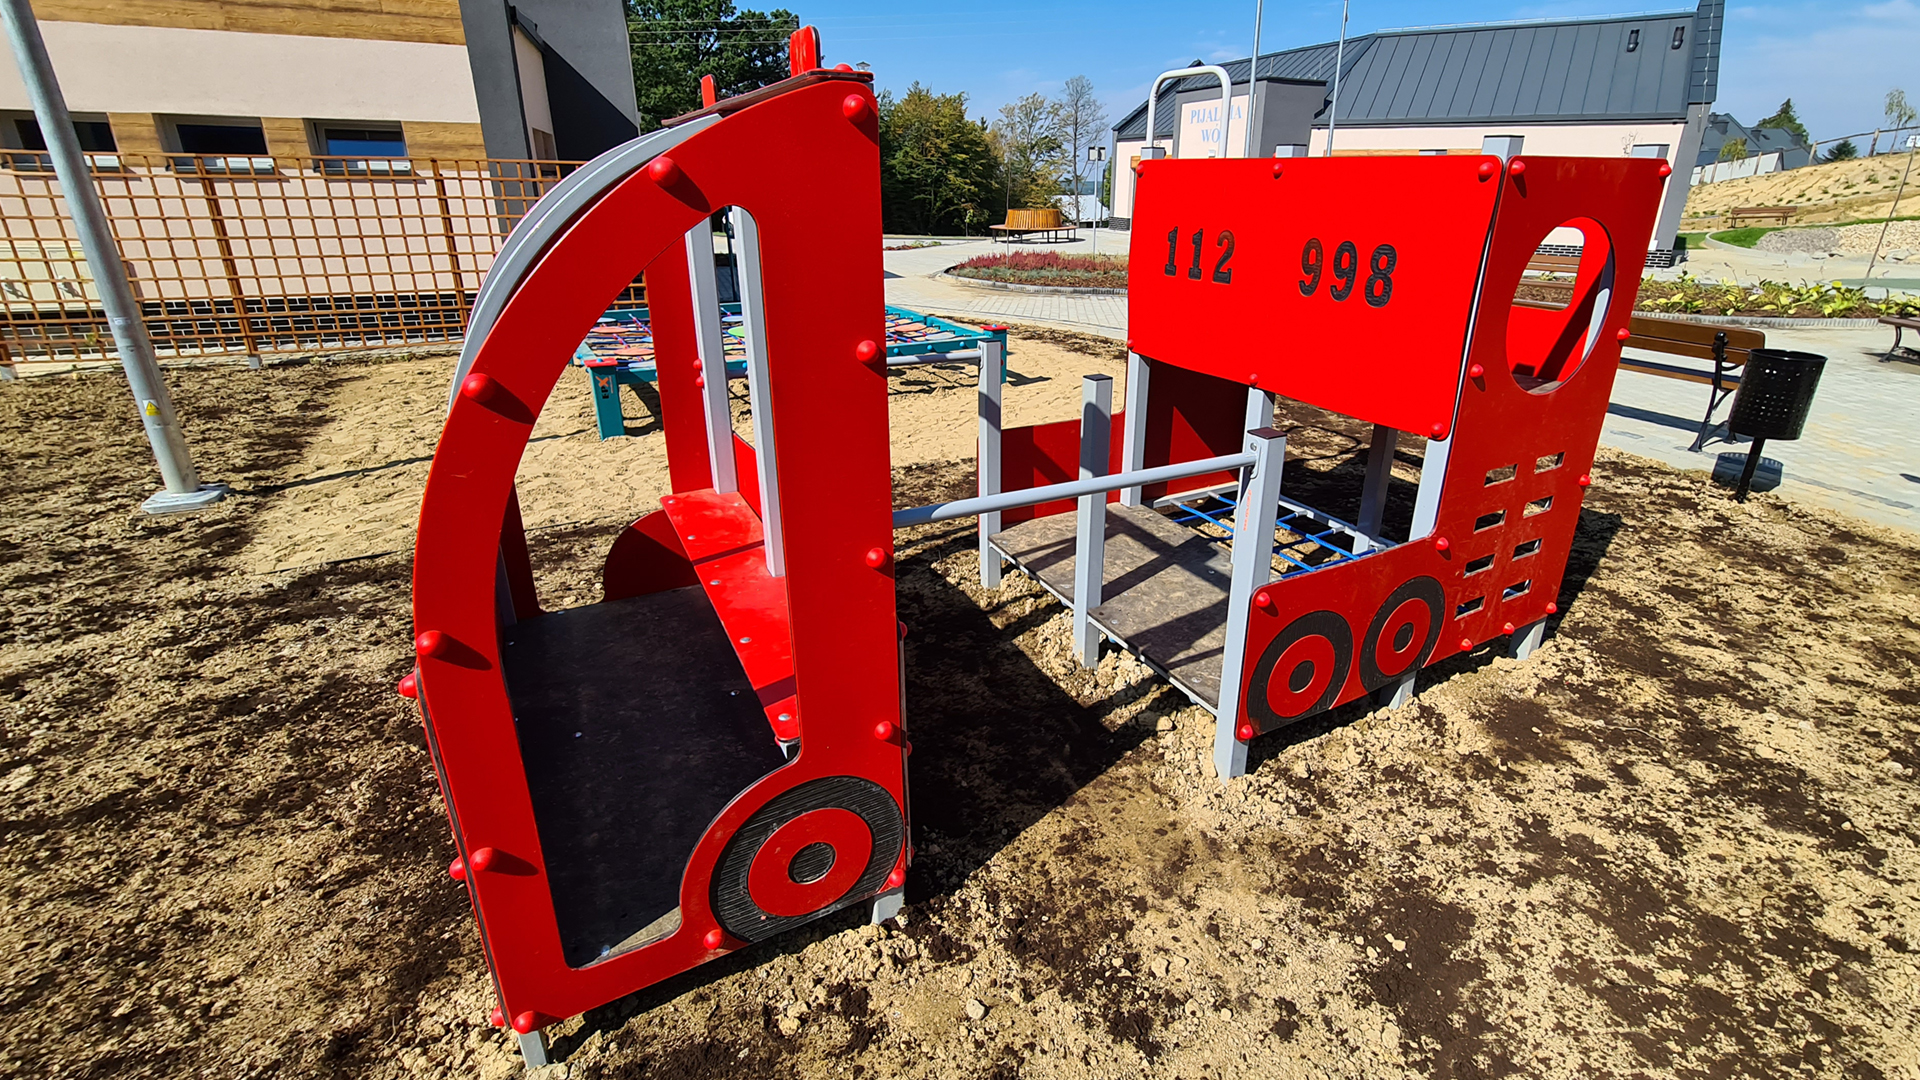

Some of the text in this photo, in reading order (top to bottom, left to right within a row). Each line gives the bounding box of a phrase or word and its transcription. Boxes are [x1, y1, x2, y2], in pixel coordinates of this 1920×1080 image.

[1190, 105, 1242, 124] PIJALIA
[1201, 123, 1221, 143] WÓ
[1164, 226, 1397, 308] 112 998
